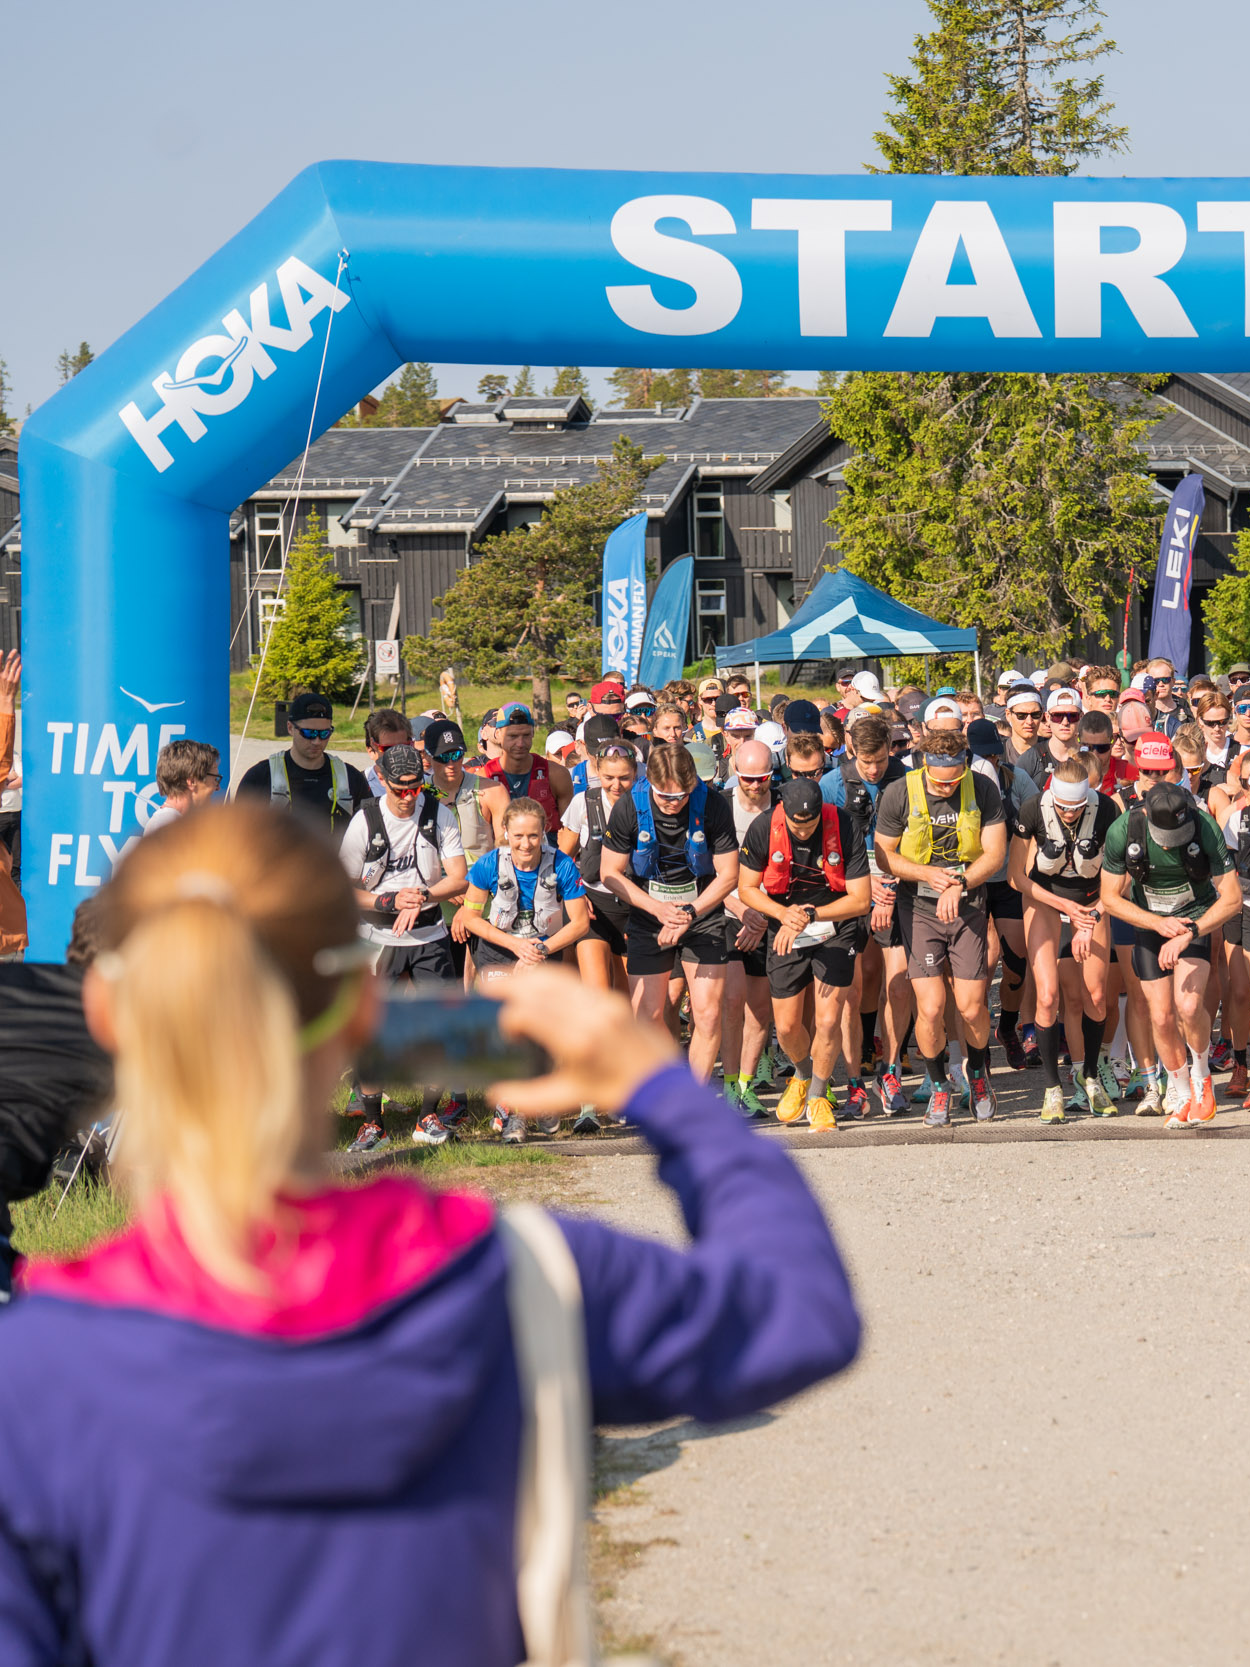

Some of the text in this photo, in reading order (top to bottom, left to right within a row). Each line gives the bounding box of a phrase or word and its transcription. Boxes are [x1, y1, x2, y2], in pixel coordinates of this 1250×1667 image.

[118, 255, 351, 473] HOKA
[632, 579, 645, 604] FLY
[1162, 507, 1191, 609] LEKI
[630, 606, 645, 665] HUMAN
